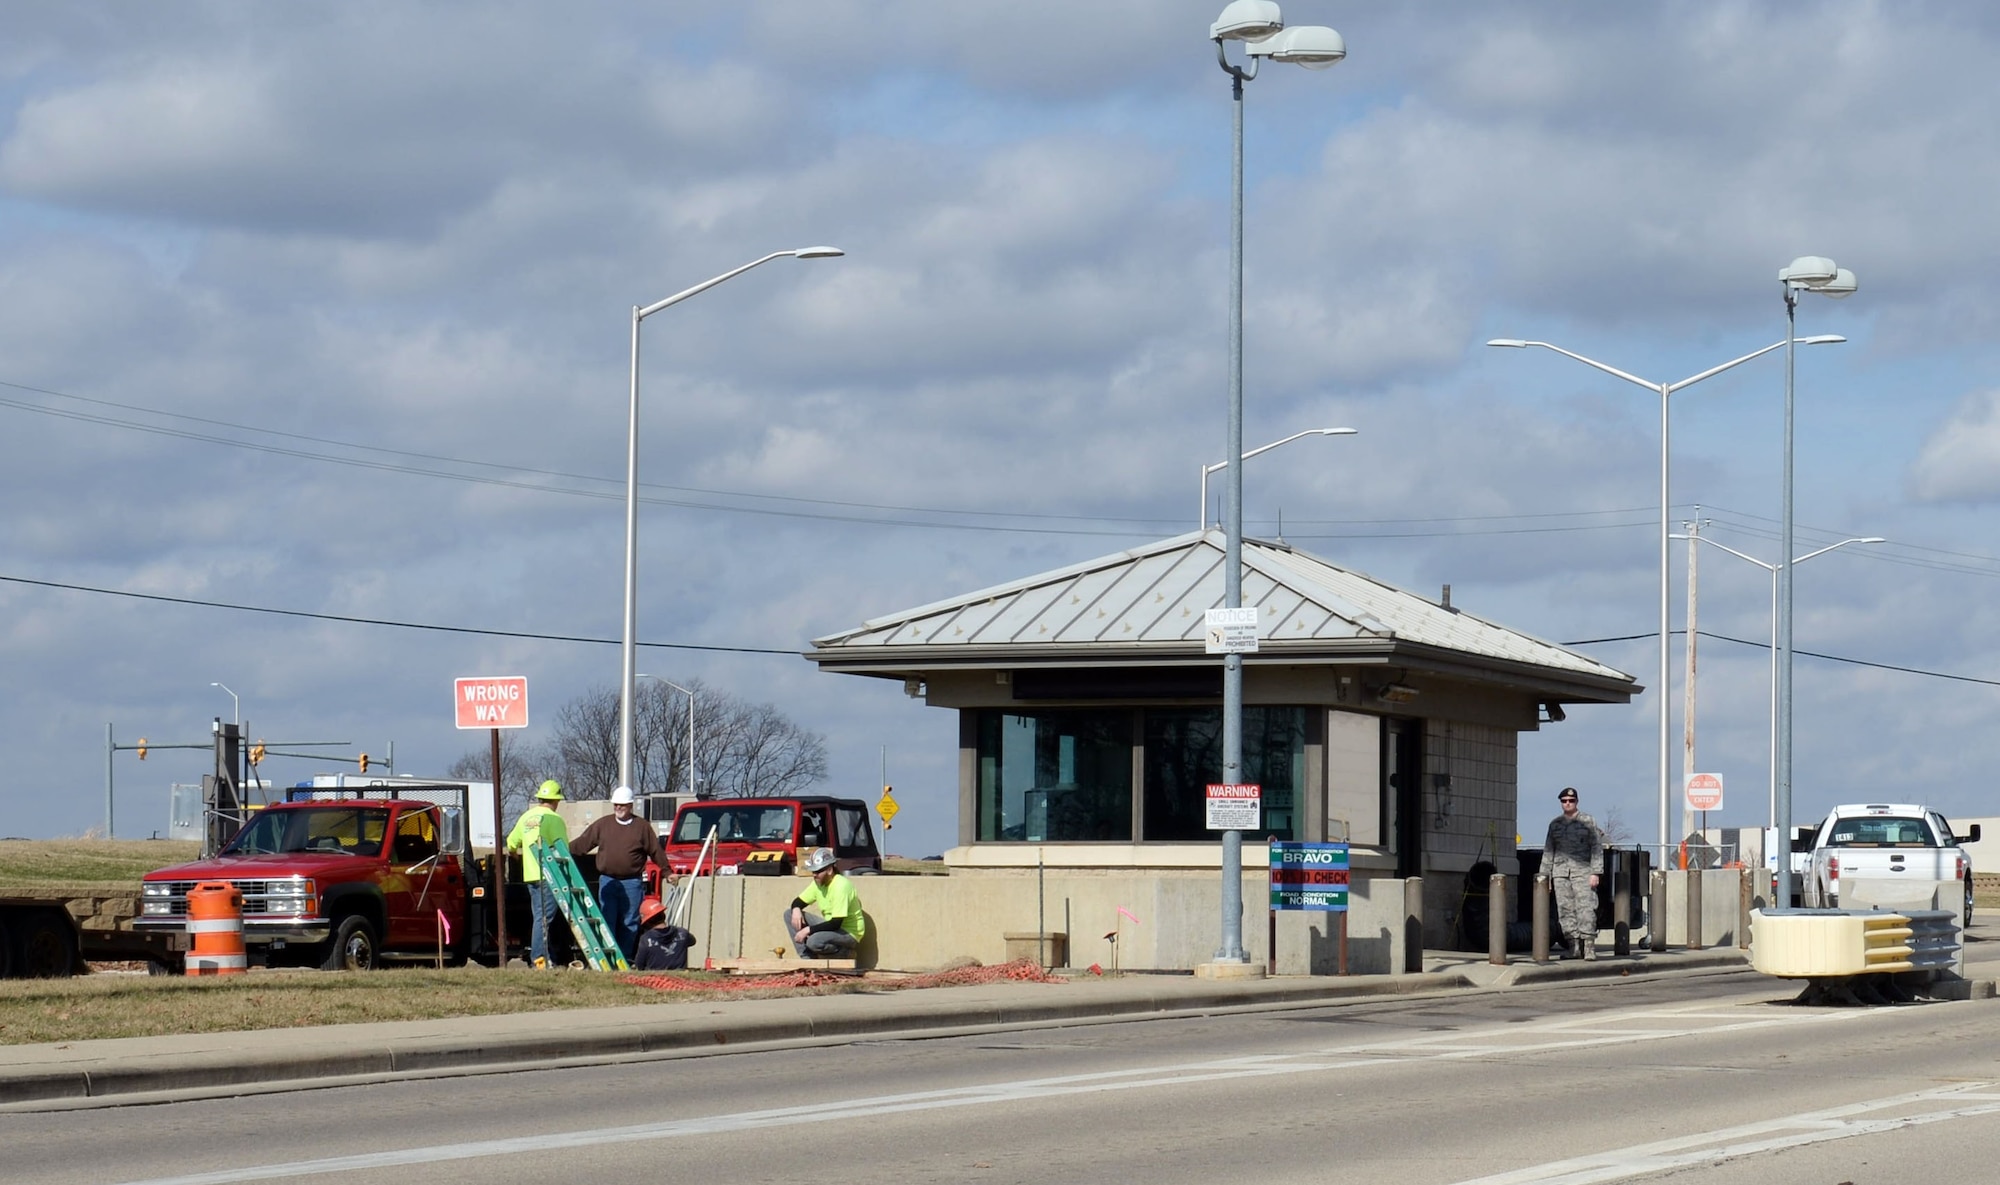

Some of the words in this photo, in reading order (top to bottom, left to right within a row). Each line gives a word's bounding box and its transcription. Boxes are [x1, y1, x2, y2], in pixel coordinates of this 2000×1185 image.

[1208, 610, 1255, 622] NOTICE
[464, 684, 519, 701] WRONG
[475, 704, 509, 721] WAY
[1209, 785, 1259, 797] WARNING
[1283, 853, 1333, 863] BRAVO
[1314, 871, 1348, 884] CHECK
[1289, 897, 1329, 906] NORMAL
